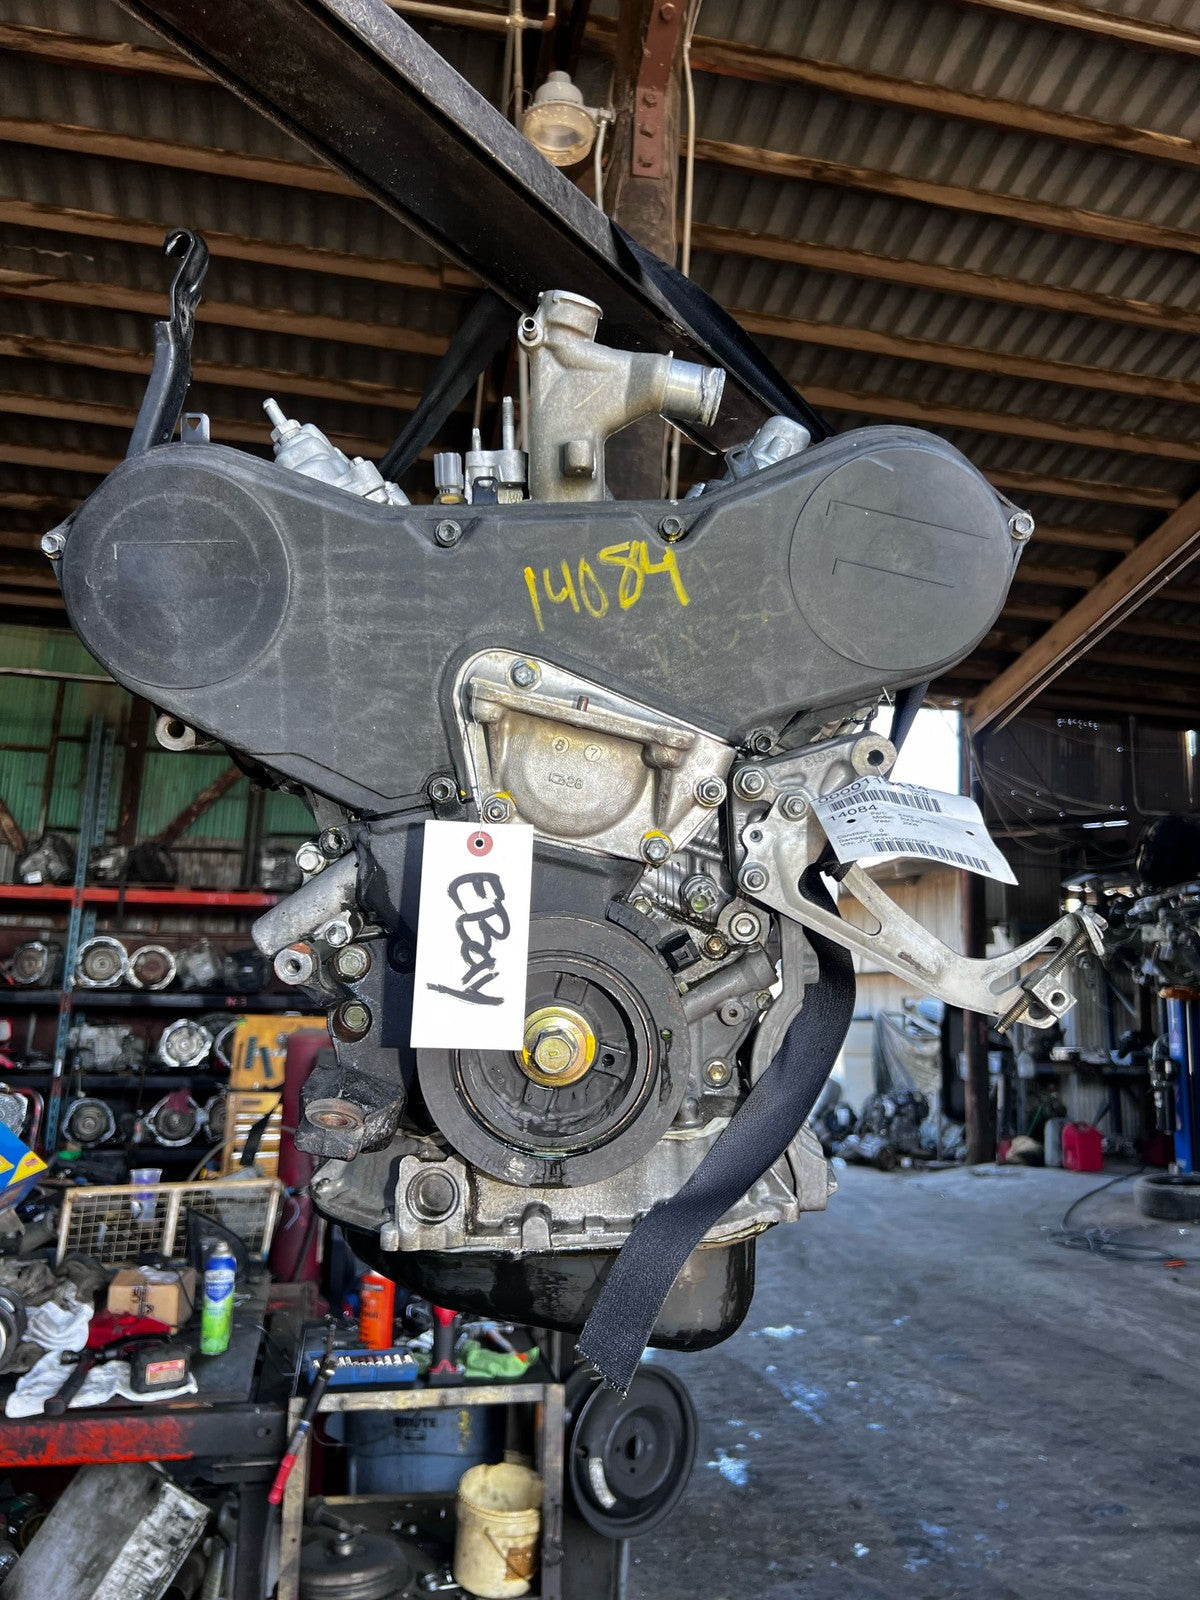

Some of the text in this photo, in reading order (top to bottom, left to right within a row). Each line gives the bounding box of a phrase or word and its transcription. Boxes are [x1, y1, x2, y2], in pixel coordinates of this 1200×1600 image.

[523, 540, 690, 632] 14084
[829, 804, 879, 821] 14084
[838, 835, 868, 844] Damage
